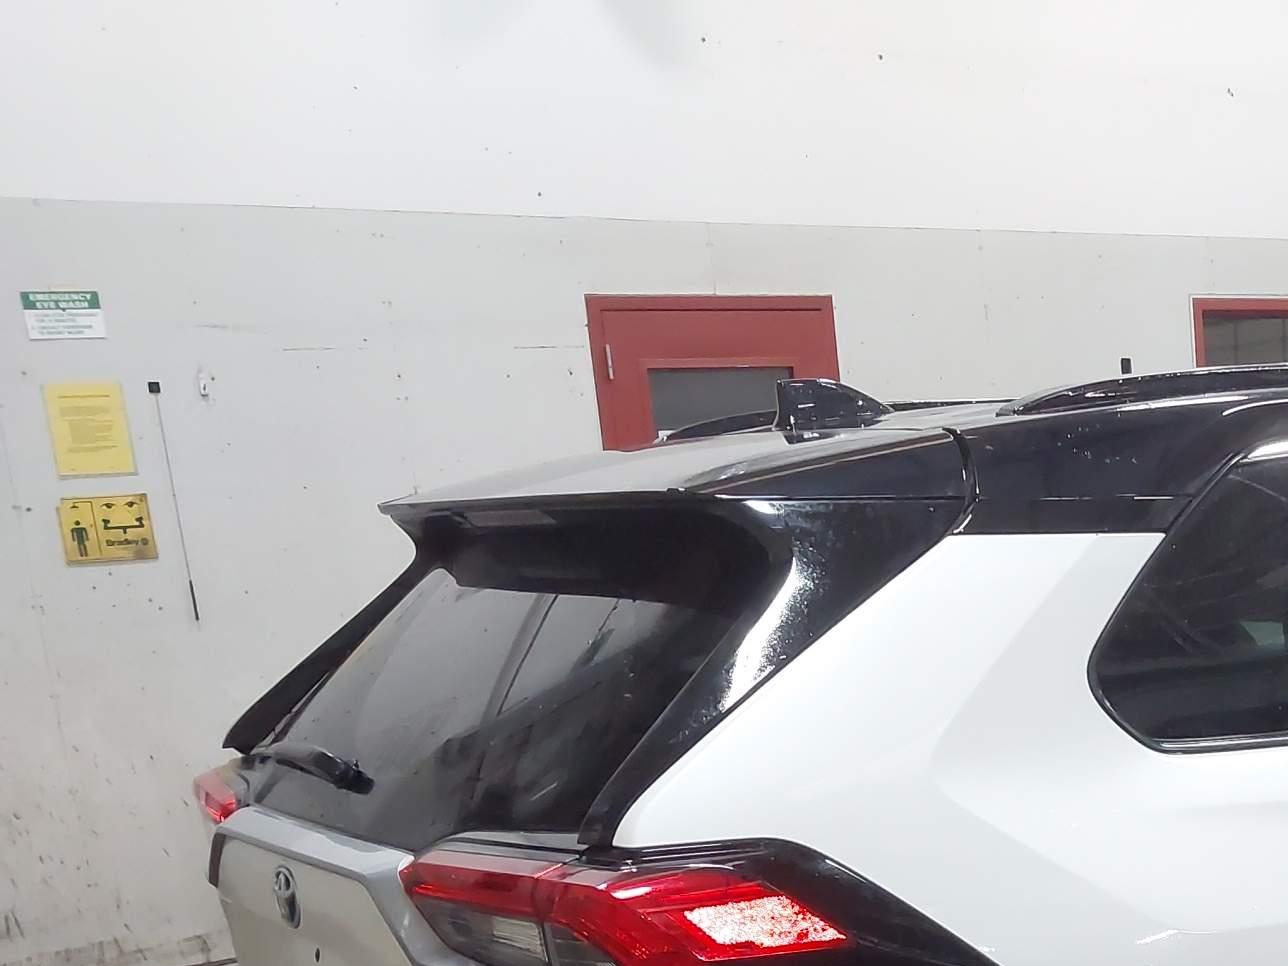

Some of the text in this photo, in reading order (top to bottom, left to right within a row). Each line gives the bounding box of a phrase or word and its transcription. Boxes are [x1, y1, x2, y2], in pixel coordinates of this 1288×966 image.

[28, 293, 92, 301] EMERGENCY
[35, 301, 89, 309] EYE WASH
[105, 538, 140, 547] Bradley
